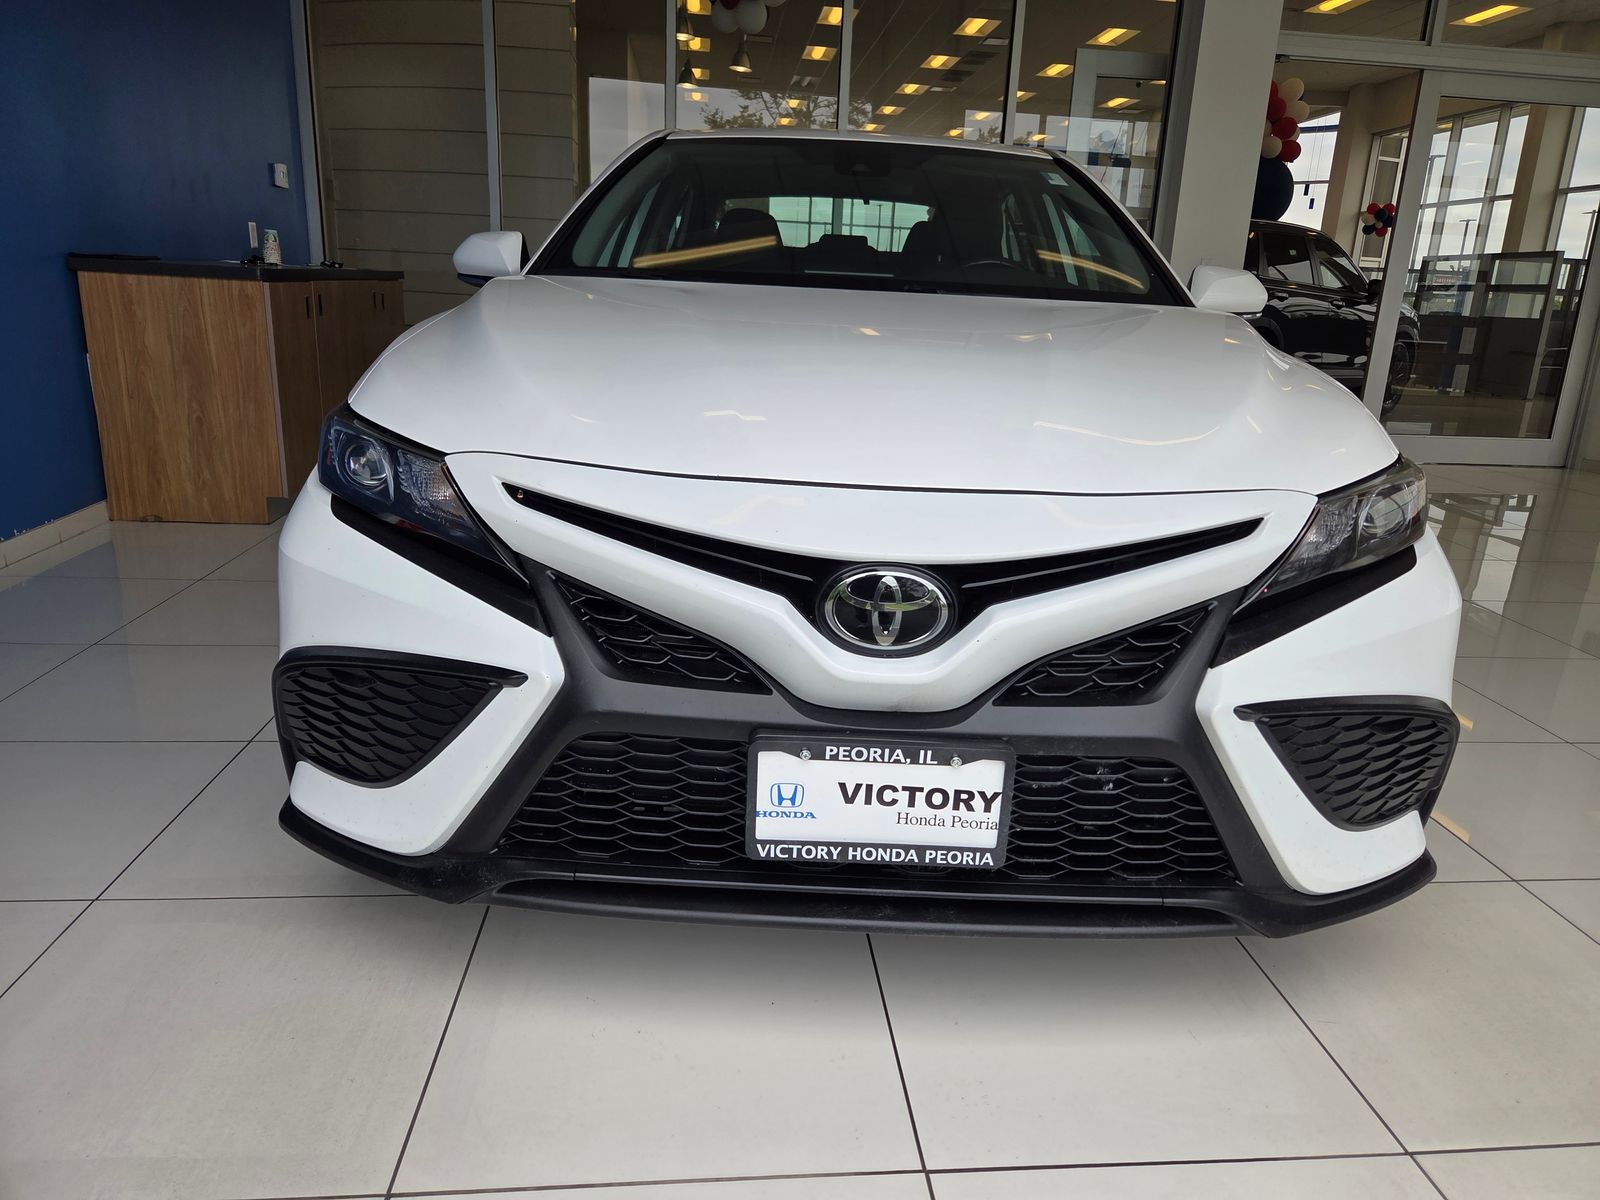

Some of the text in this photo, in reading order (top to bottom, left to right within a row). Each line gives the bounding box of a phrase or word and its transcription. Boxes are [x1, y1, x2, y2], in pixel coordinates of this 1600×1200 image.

[825, 746, 938, 765] PEORIA, IL
[838, 782, 1002, 813] VICTORY
[756, 810, 816, 819] HONDA
[896, 812, 999, 830] Honda Peoria
[757, 844, 994, 866] VICTORY HONDA PEORIA
